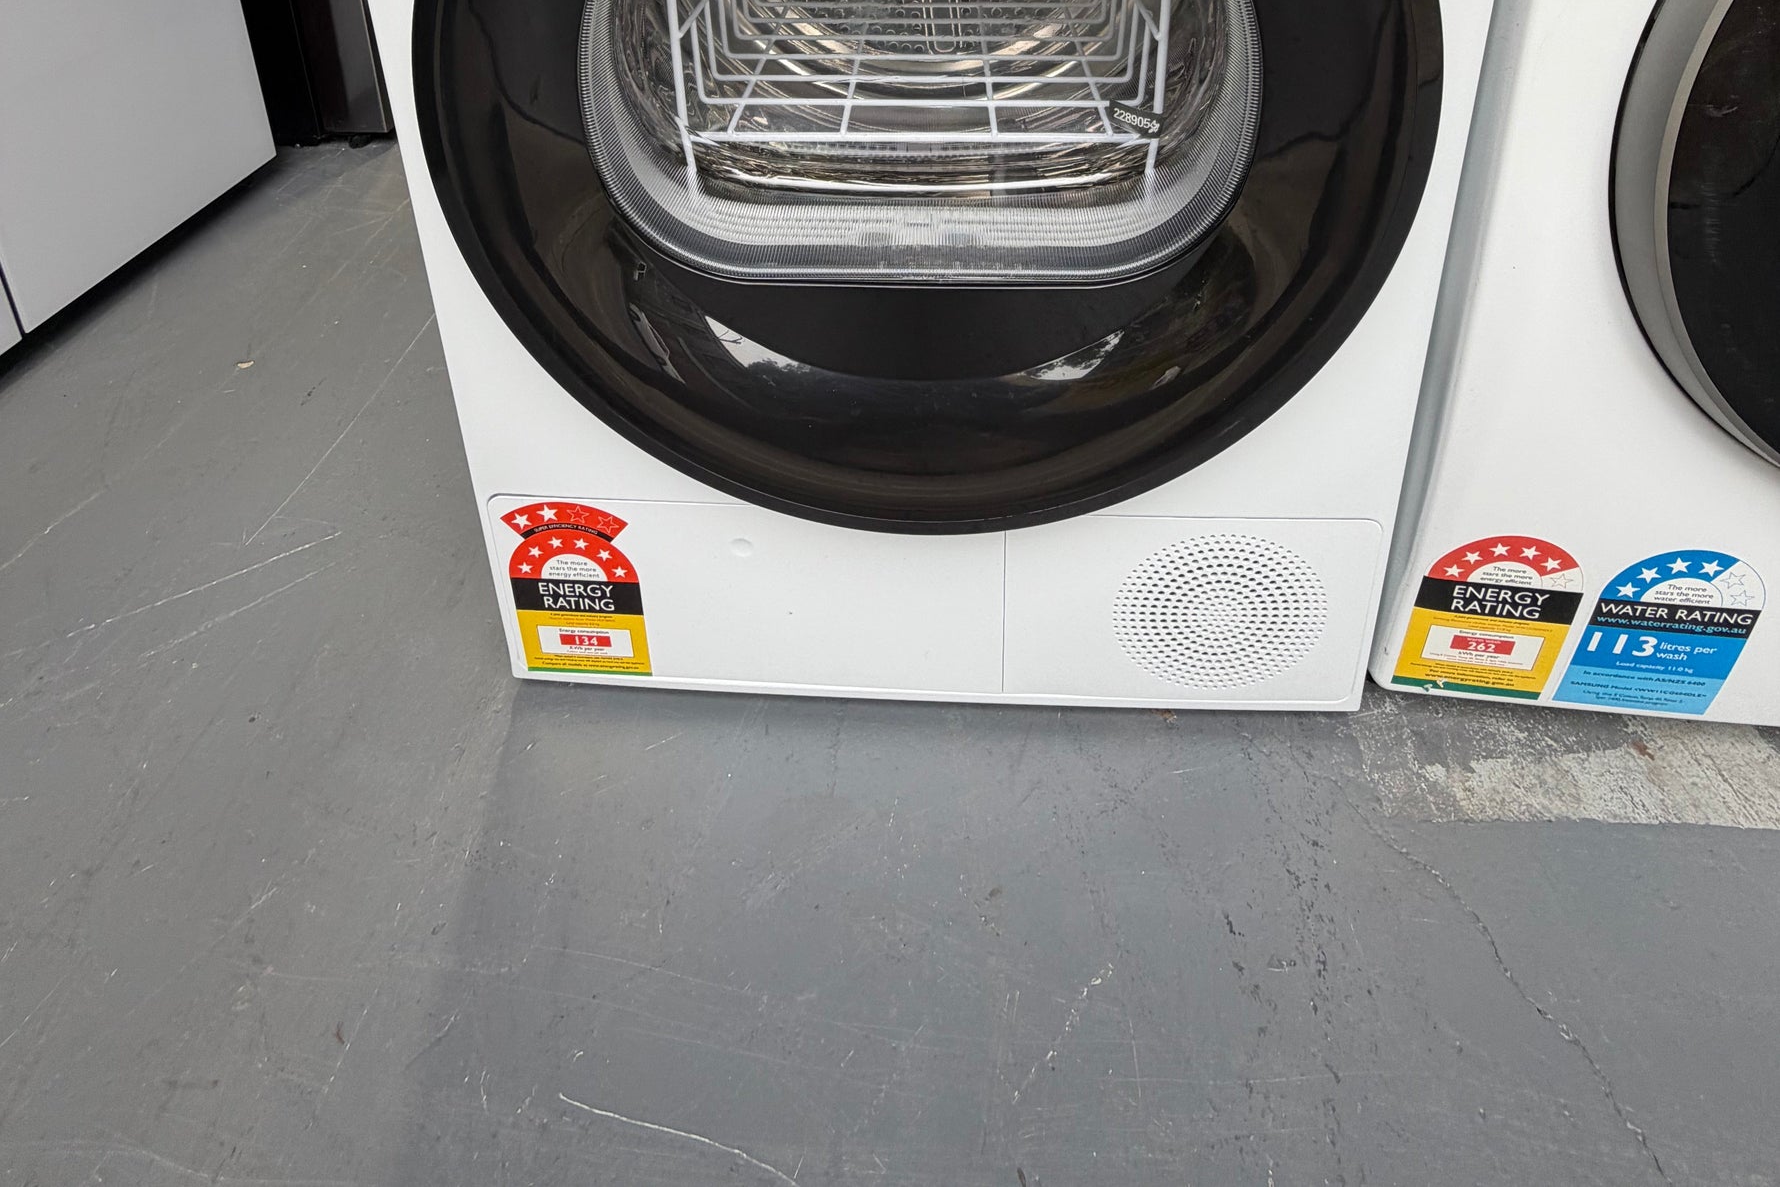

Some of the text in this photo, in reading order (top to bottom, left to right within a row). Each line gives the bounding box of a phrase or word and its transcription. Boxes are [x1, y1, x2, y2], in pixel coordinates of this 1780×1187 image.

[538, 582, 613, 597] ENERGY
[1453, 585, 1550, 606] ENERGY
[543, 596, 615, 611] RATING
[1679, 597, 1711, 605] efficient
[1451, 599, 1541, 619] RATING
[1601, 602, 1754, 626] WATER RATING
[1597, 616, 1746, 634] www.waterrating.gov.au
[574, 636, 598, 646] 134
[1467, 642, 1496, 652] 262
[1587, 631, 1717, 657] 113 litres per
[1656, 652, 1687, 661] wash
